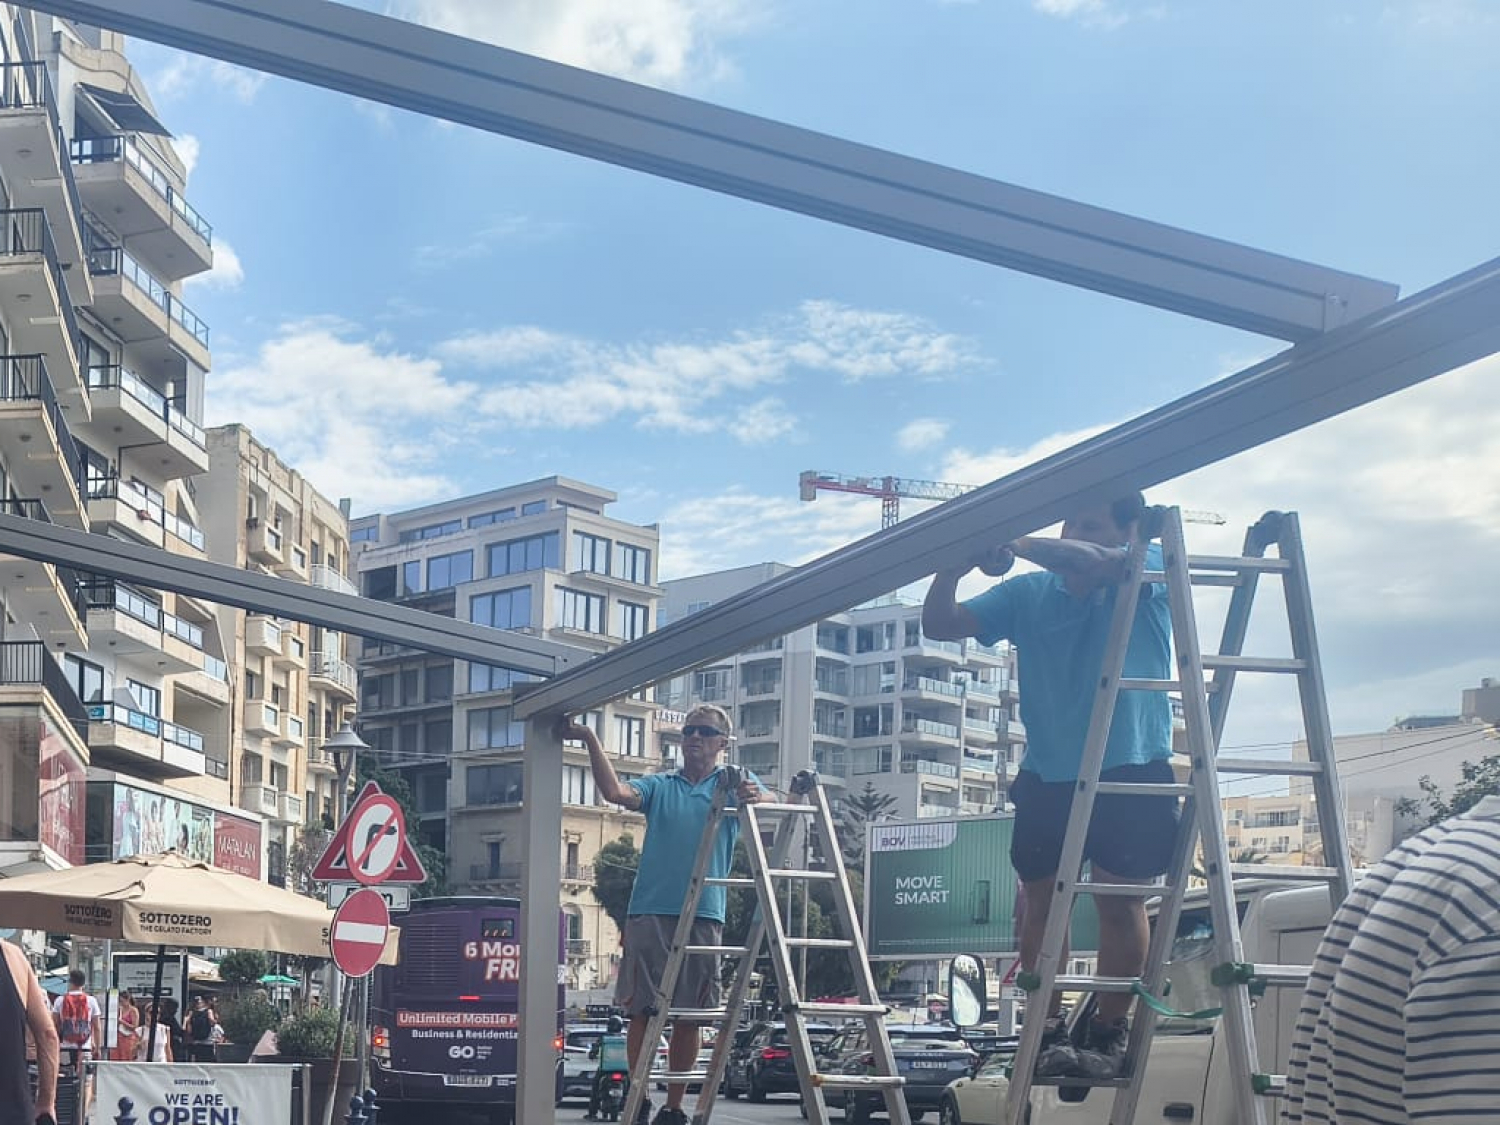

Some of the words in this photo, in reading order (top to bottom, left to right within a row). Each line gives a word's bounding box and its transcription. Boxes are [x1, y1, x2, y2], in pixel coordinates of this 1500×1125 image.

[217, 834, 257, 862] MATALAN
[895, 875, 944, 890] MOVE
[894, 890, 950, 905] SMART
[139, 912, 212, 927] SOTTOZERO
[140, 924, 153, 932] THE
[154, 925, 180, 934] GELATO
[182, 927, 212, 936] FACTORY
[465, 941, 477, 959] 6
[485, 957, 519, 981] FR
[400, 1012, 460, 1025] Unlimited
[463, 1013, 507, 1025] Mobile
[412, 1029, 455, 1038] Business
[456, 1029, 464, 1038] &
[465, 1029, 519, 1040] Residentia
[448, 1045, 475, 1059] GO
[165, 1093, 190, 1106] WE
[193, 1093, 224, 1106] ARE
